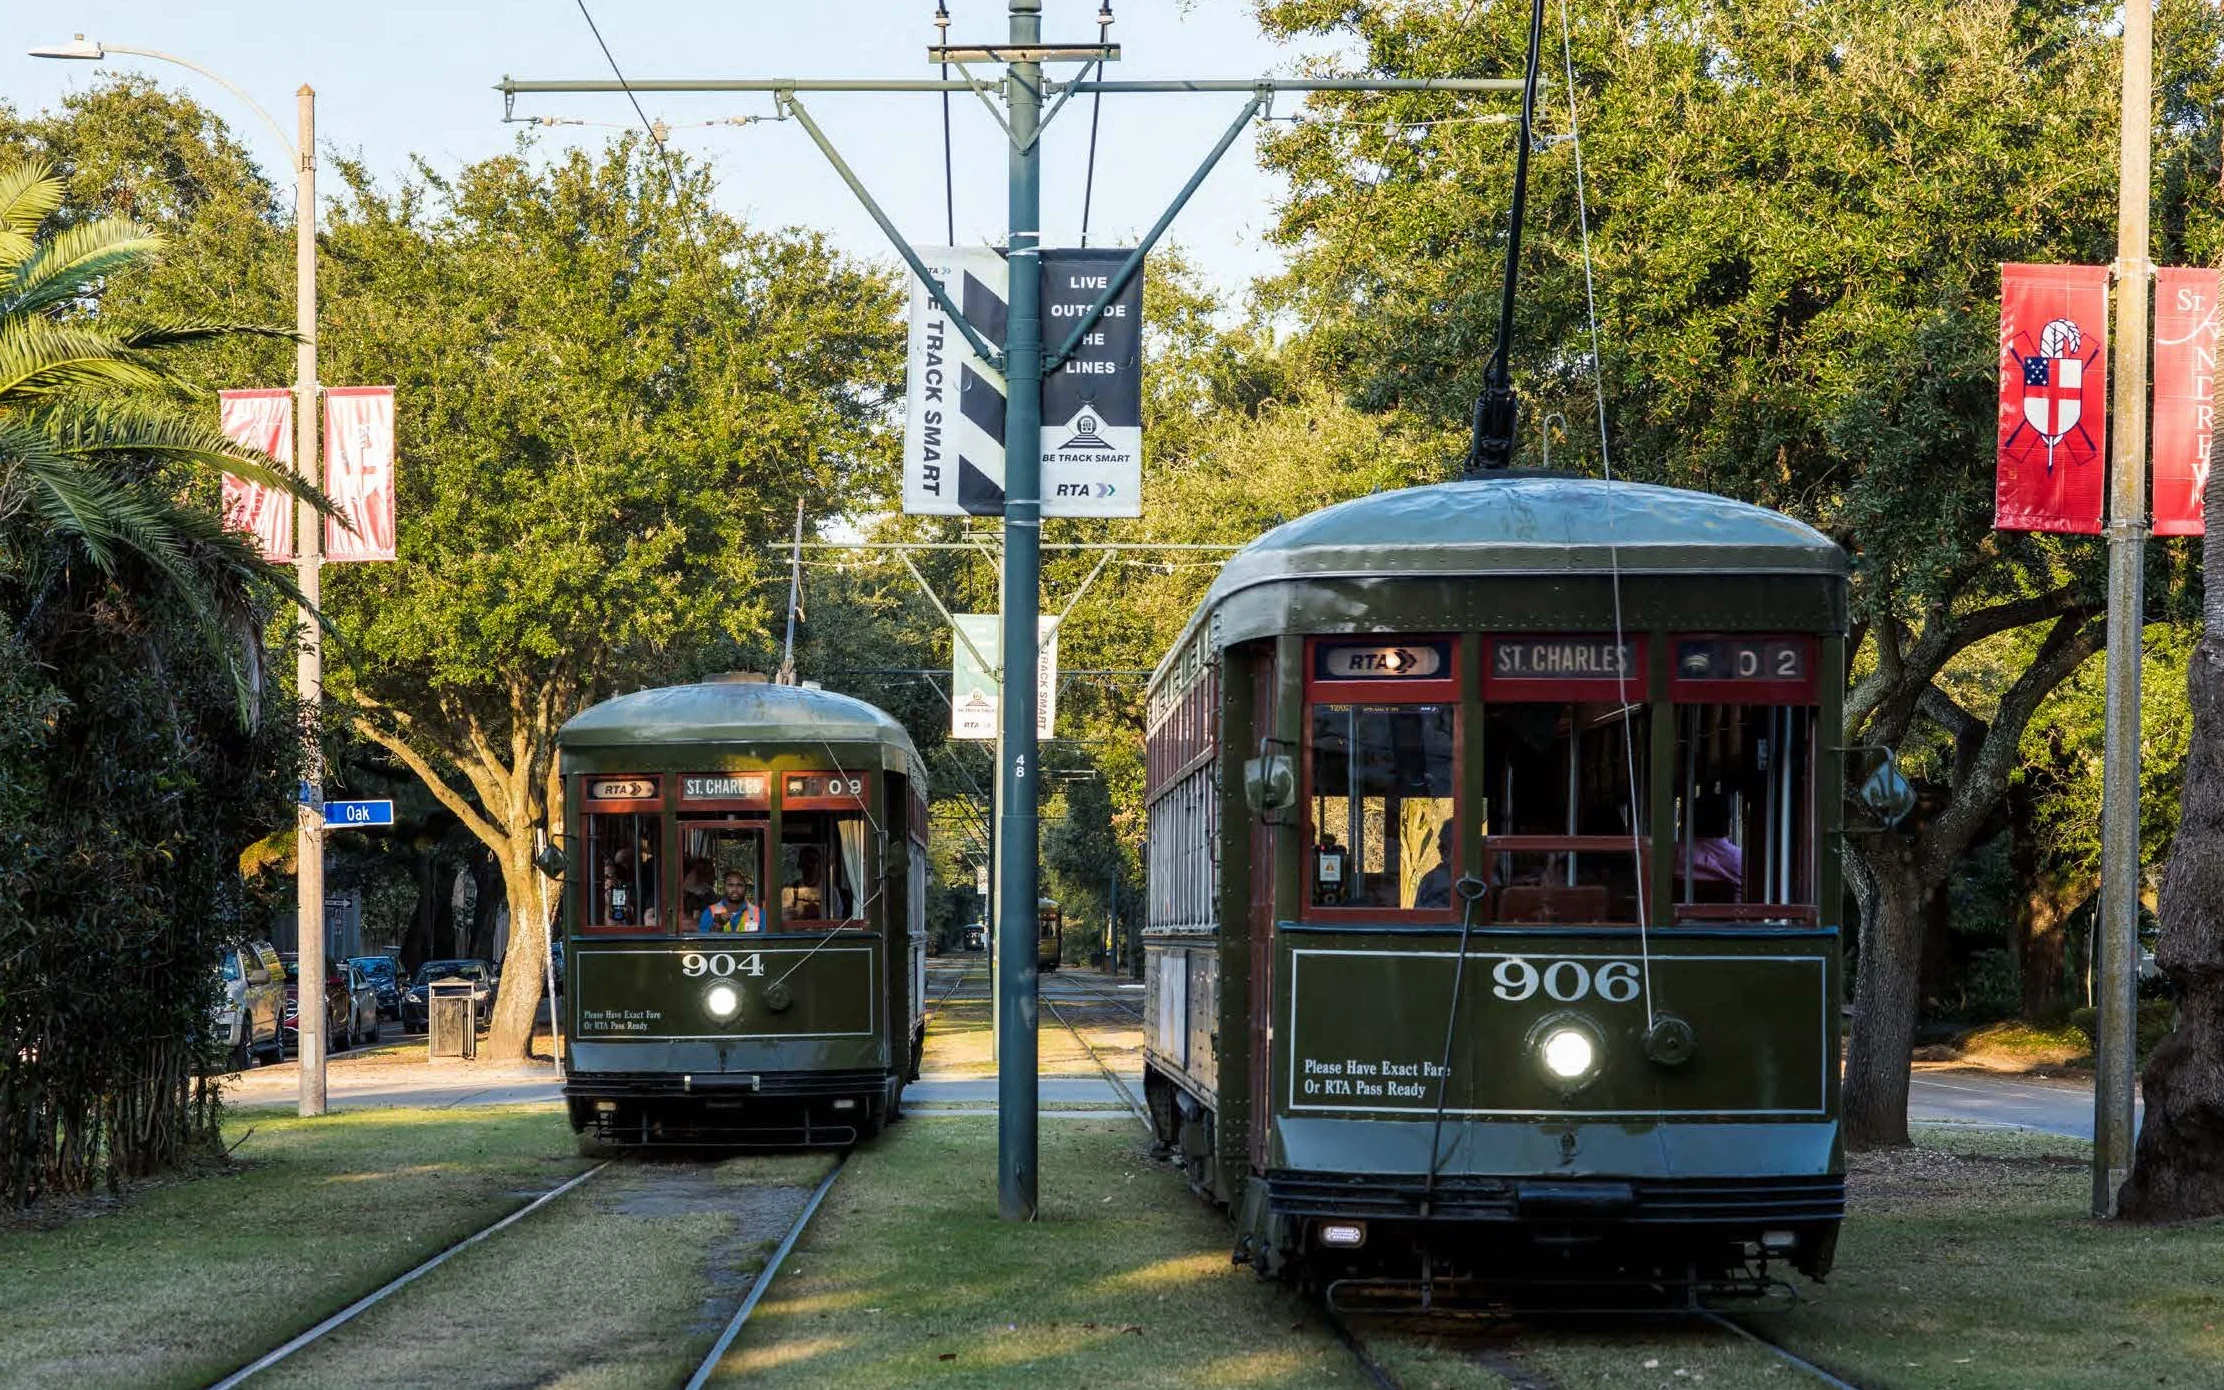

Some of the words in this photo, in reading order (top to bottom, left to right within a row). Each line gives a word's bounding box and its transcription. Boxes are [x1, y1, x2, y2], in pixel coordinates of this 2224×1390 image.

[1070, 276, 1108, 289] LIVE
[1051, 304, 1127, 317] OUTDE
[925, 320, 944, 403] TRACK
[1066, 361, 1116, 374] LINES
[923, 410, 942, 497] SMART
[1042, 454, 1056, 462] BE
[1058, 454, 1093, 462] TRACK
[1095, 454, 1131, 463] SMART
[1056, 484, 1090, 496] RTA
[1348, 654, 1389, 670] RTA
[1498, 646, 1527, 672] ST.
[1531, 645, 1628, 673] CHARLES
[1038, 691, 1048, 730] SMART
[604, 784, 628, 795] RTA
[687, 779, 703, 795] ST.
[705, 778, 760, 795] CHARLES
[346, 804, 371, 822] Oak
[682, 953, 765, 977] 904
[1492, 960, 1641, 1003] 906
[584, 1010, 603, 1019] Please
[605, 1010, 621, 1019] Have
[624, 1010, 644, 1019] Exact
[646, 1010, 662, 1019] Fare
[584, 1021, 592, 1030] Or
[610, 1021, 625, 1030] Pass
[627, 1021, 649, 1031] Ready
[1304, 1058, 1342, 1075] Please
[1346, 1060, 1377, 1075] Have
[1381, 1060, 1418, 1076] Exact
[1304, 1079, 1320, 1094] Or
[1324, 1079, 1351, 1095] RTA
[1356, 1080, 1383, 1096] Pass
[1387, 1080, 1427, 1099] Ready
